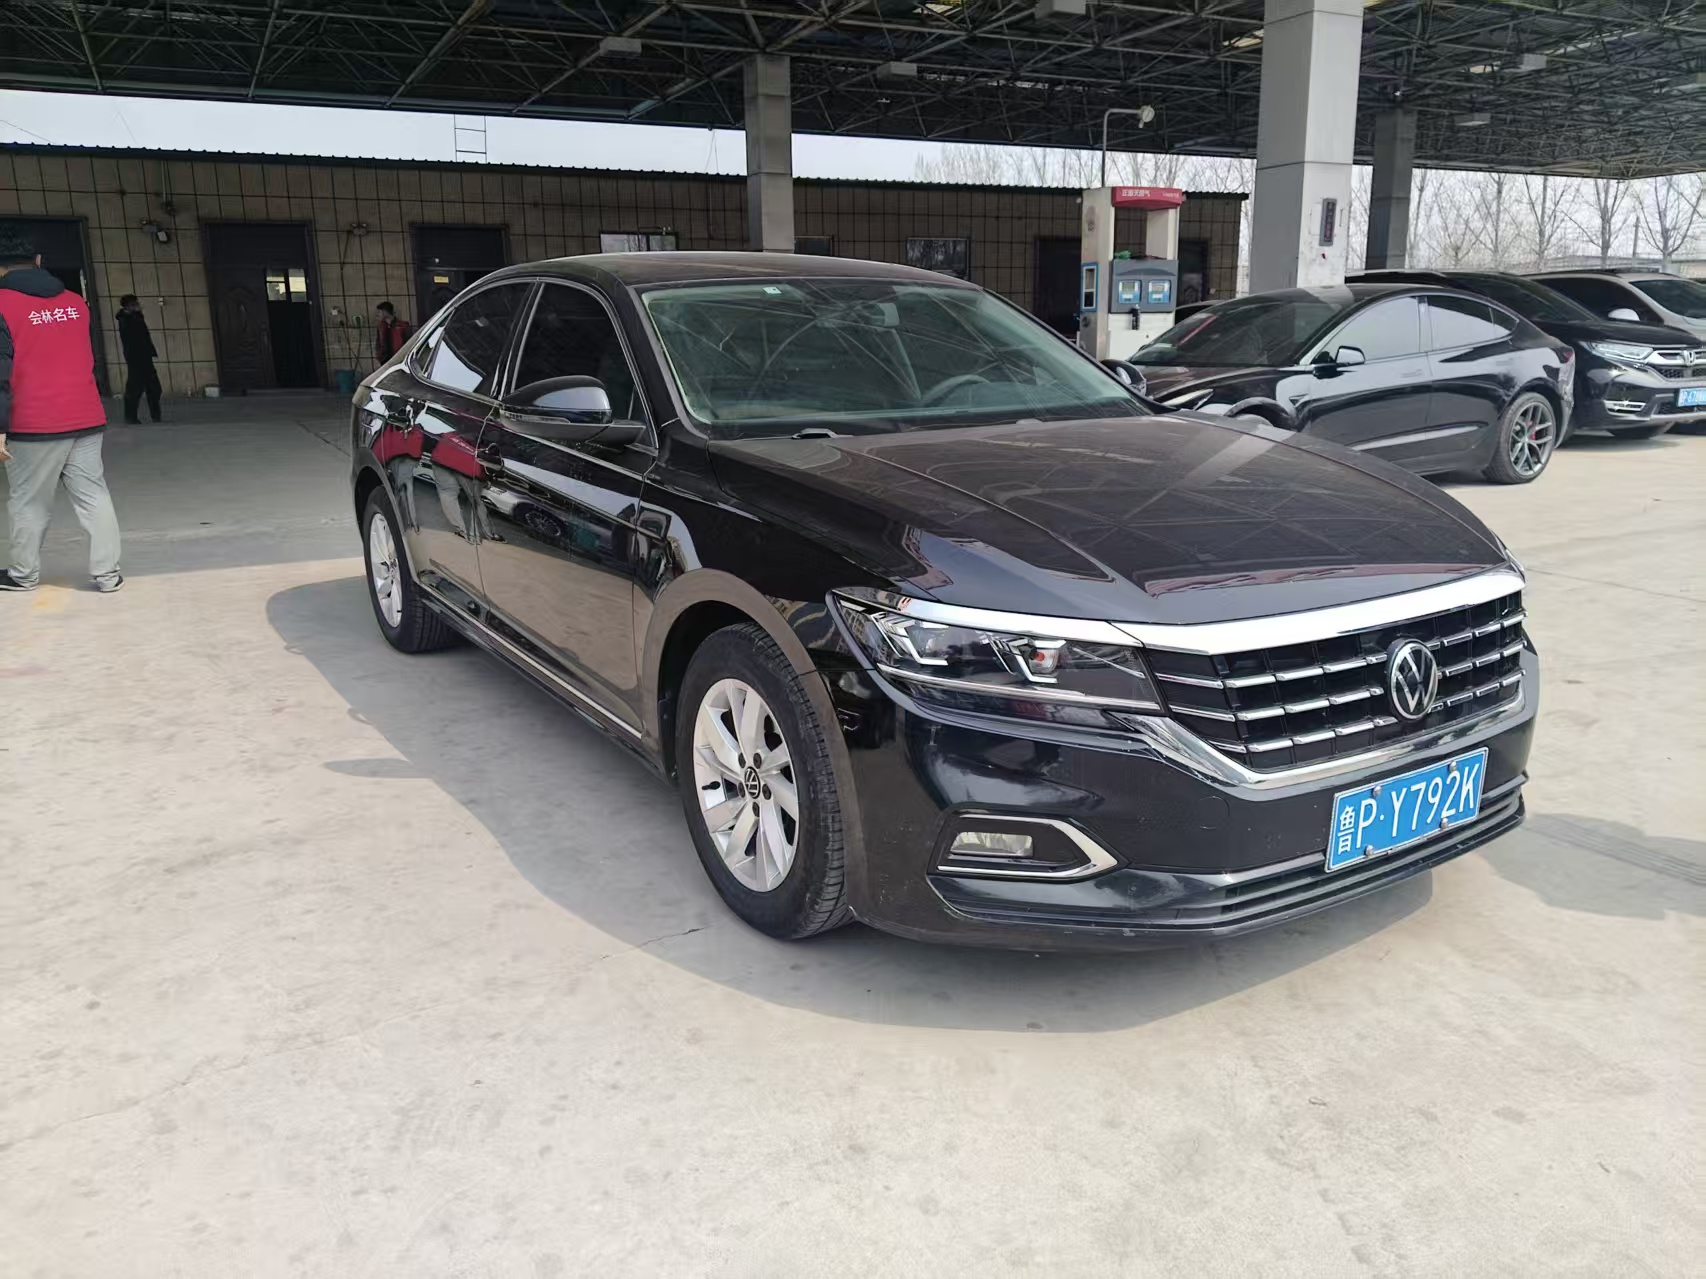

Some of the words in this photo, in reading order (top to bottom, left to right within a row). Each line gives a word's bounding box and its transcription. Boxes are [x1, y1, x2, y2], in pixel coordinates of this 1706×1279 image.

[28, 306, 80, 325] 会林名车
[1338, 763, 1480, 855] 鲁P·Y792K
